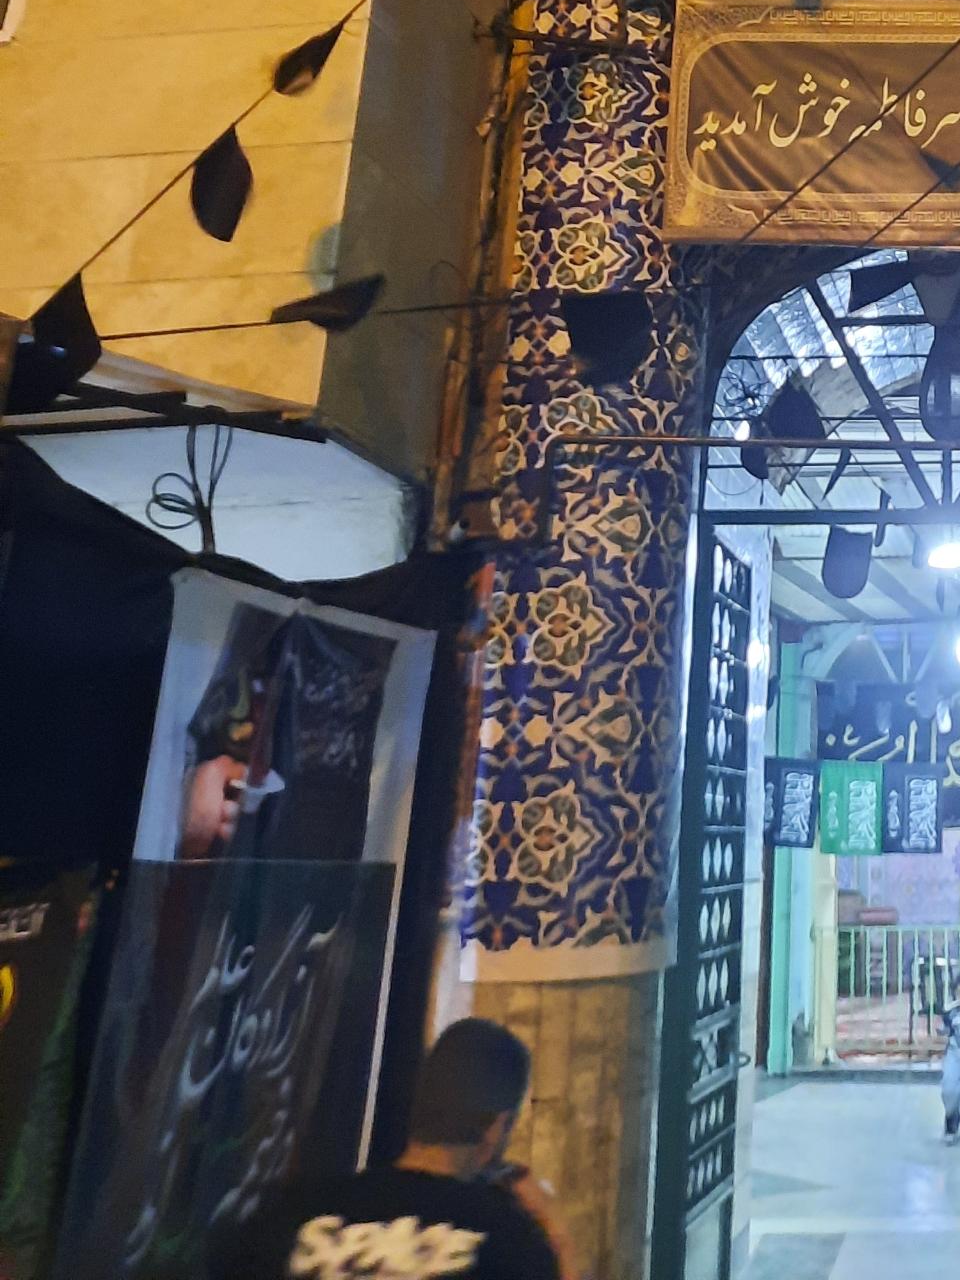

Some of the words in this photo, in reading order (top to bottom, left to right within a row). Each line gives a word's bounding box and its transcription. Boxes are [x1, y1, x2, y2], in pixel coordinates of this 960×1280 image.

[693, 79, 777, 151] آمدید
[768, 72, 850, 148] خوش
[848, 76, 926, 143] فاطمه
